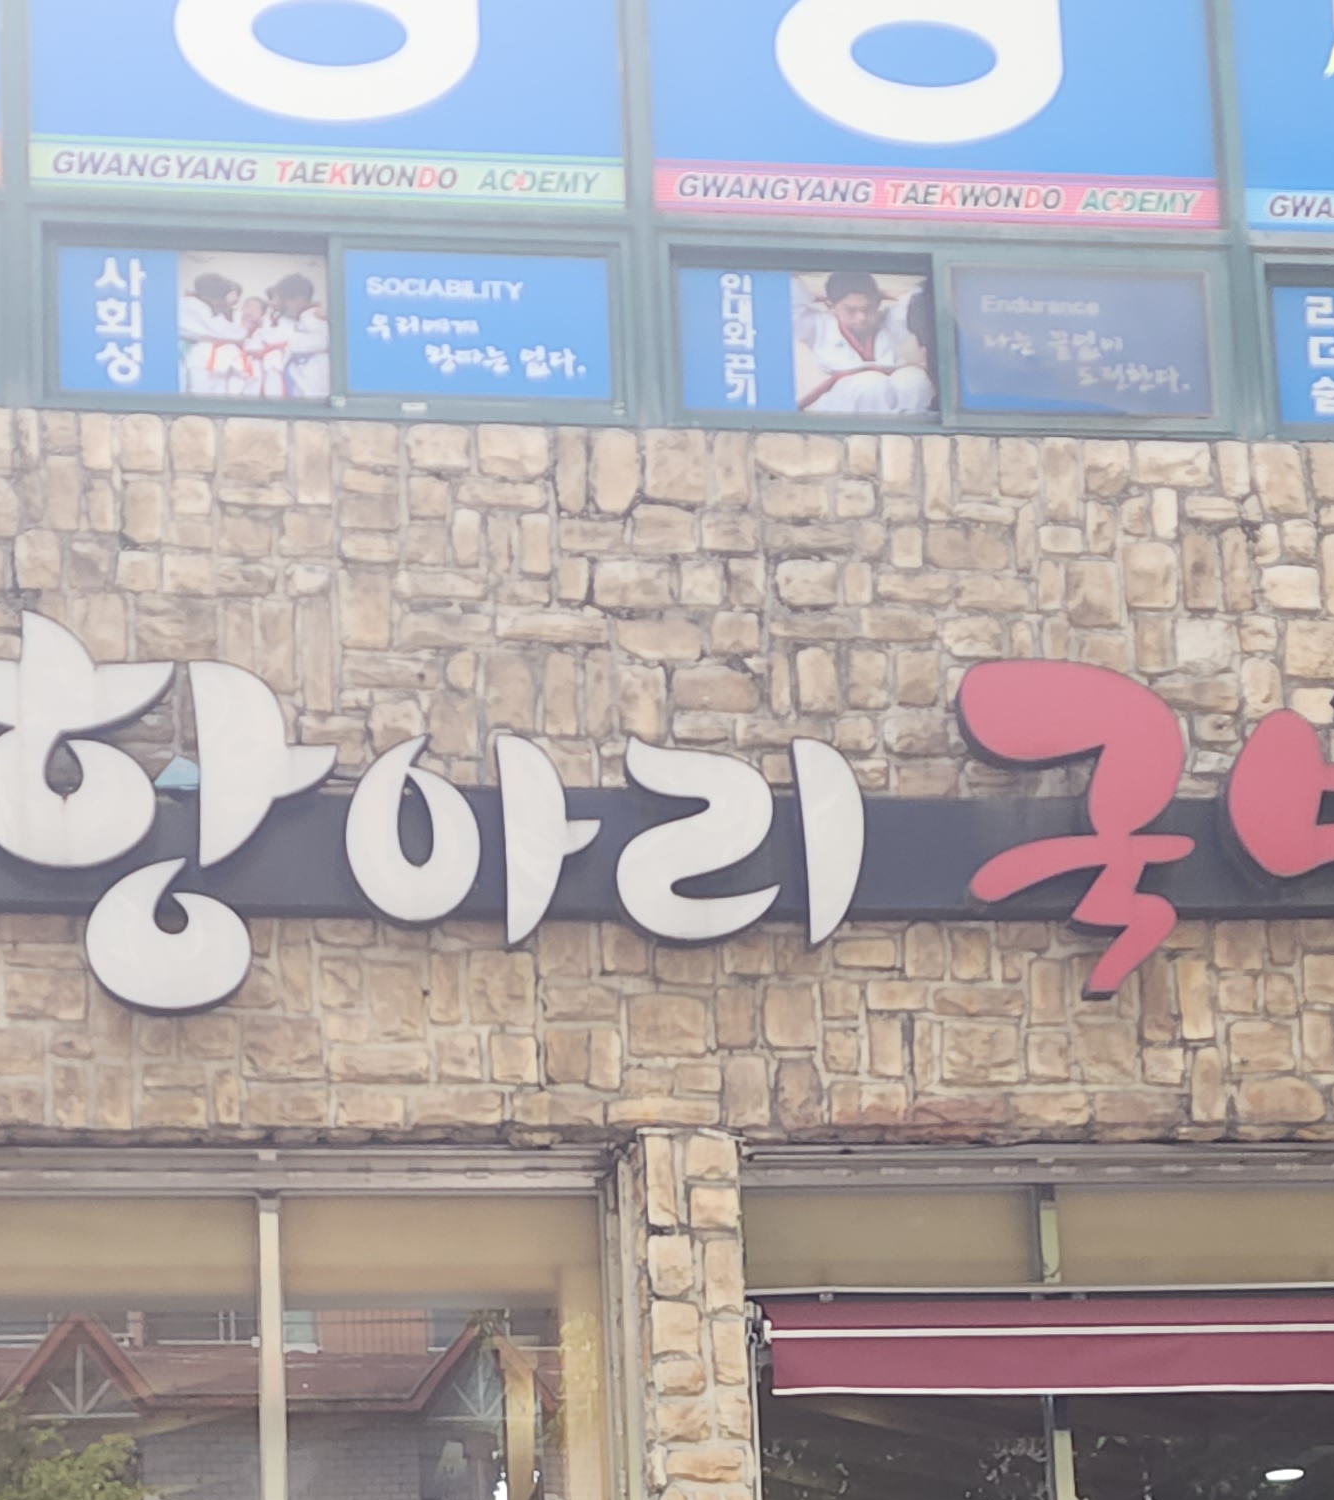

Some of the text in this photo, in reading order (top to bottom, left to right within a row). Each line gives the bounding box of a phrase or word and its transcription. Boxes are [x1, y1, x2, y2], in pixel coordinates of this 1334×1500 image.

[52, 150, 257, 182] GWANGYANG
[275, 158, 458, 190] TAEKWONDO
[678, 172, 872, 204] GWANGYANG
[889, 182, 1061, 210] TAEKWONDO
[366, 276, 524, 300] SOCIABILITY
[980, 295, 1100, 317] Endurance
[94, 257, 146, 384] 사회성
